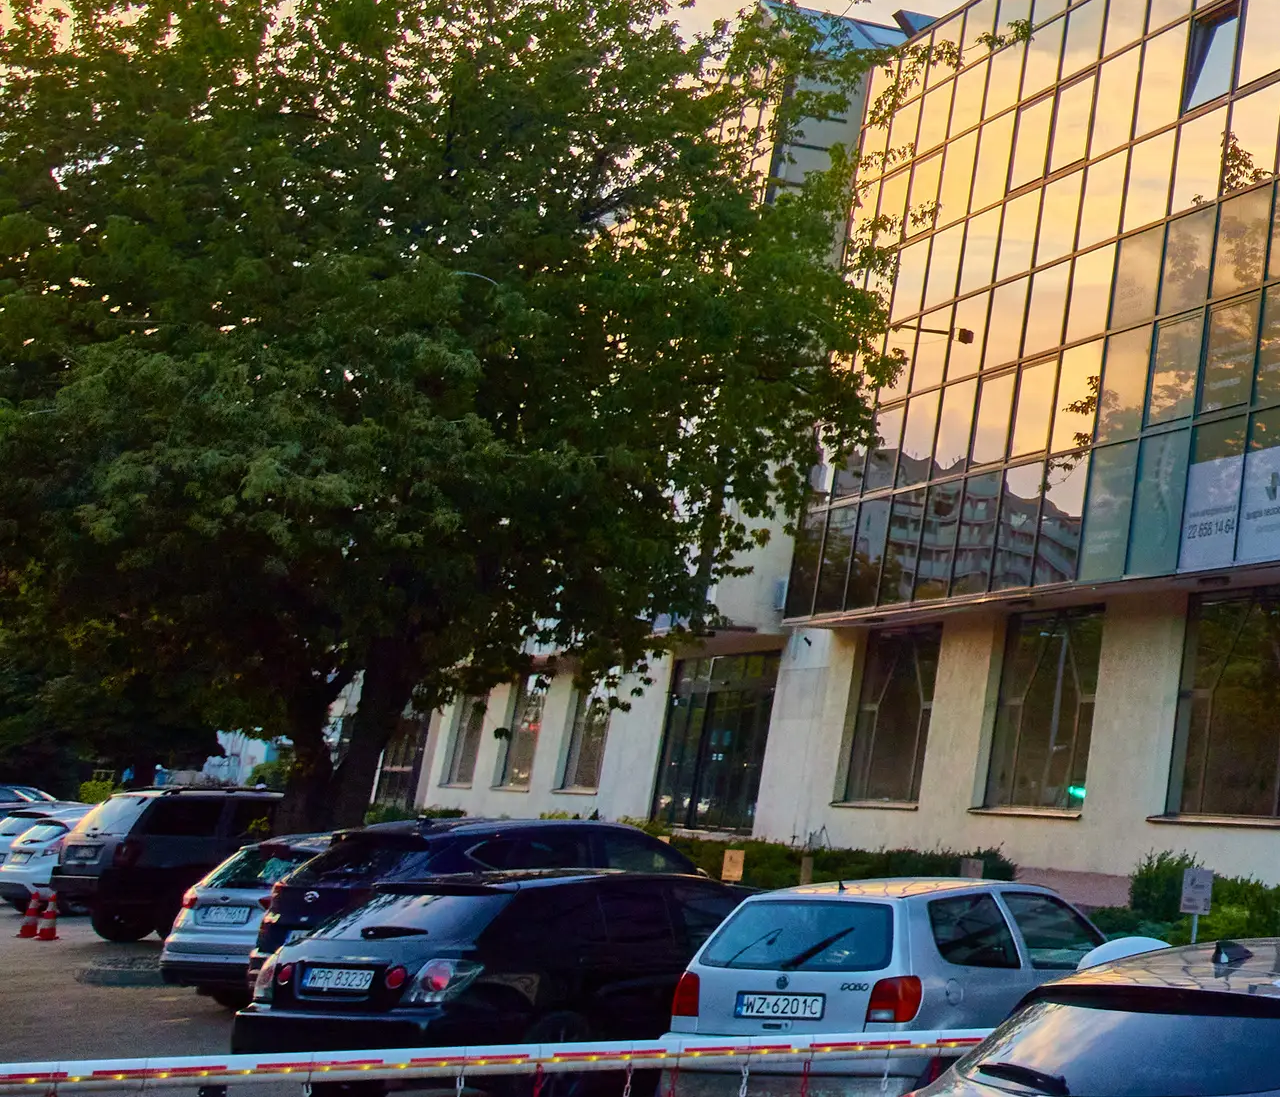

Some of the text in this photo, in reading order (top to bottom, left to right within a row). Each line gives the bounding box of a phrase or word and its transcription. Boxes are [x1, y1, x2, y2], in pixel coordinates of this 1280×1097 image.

[309, 969, 372, 988] WPR 83239
[745, 997, 819, 1015] WZ 6201C
